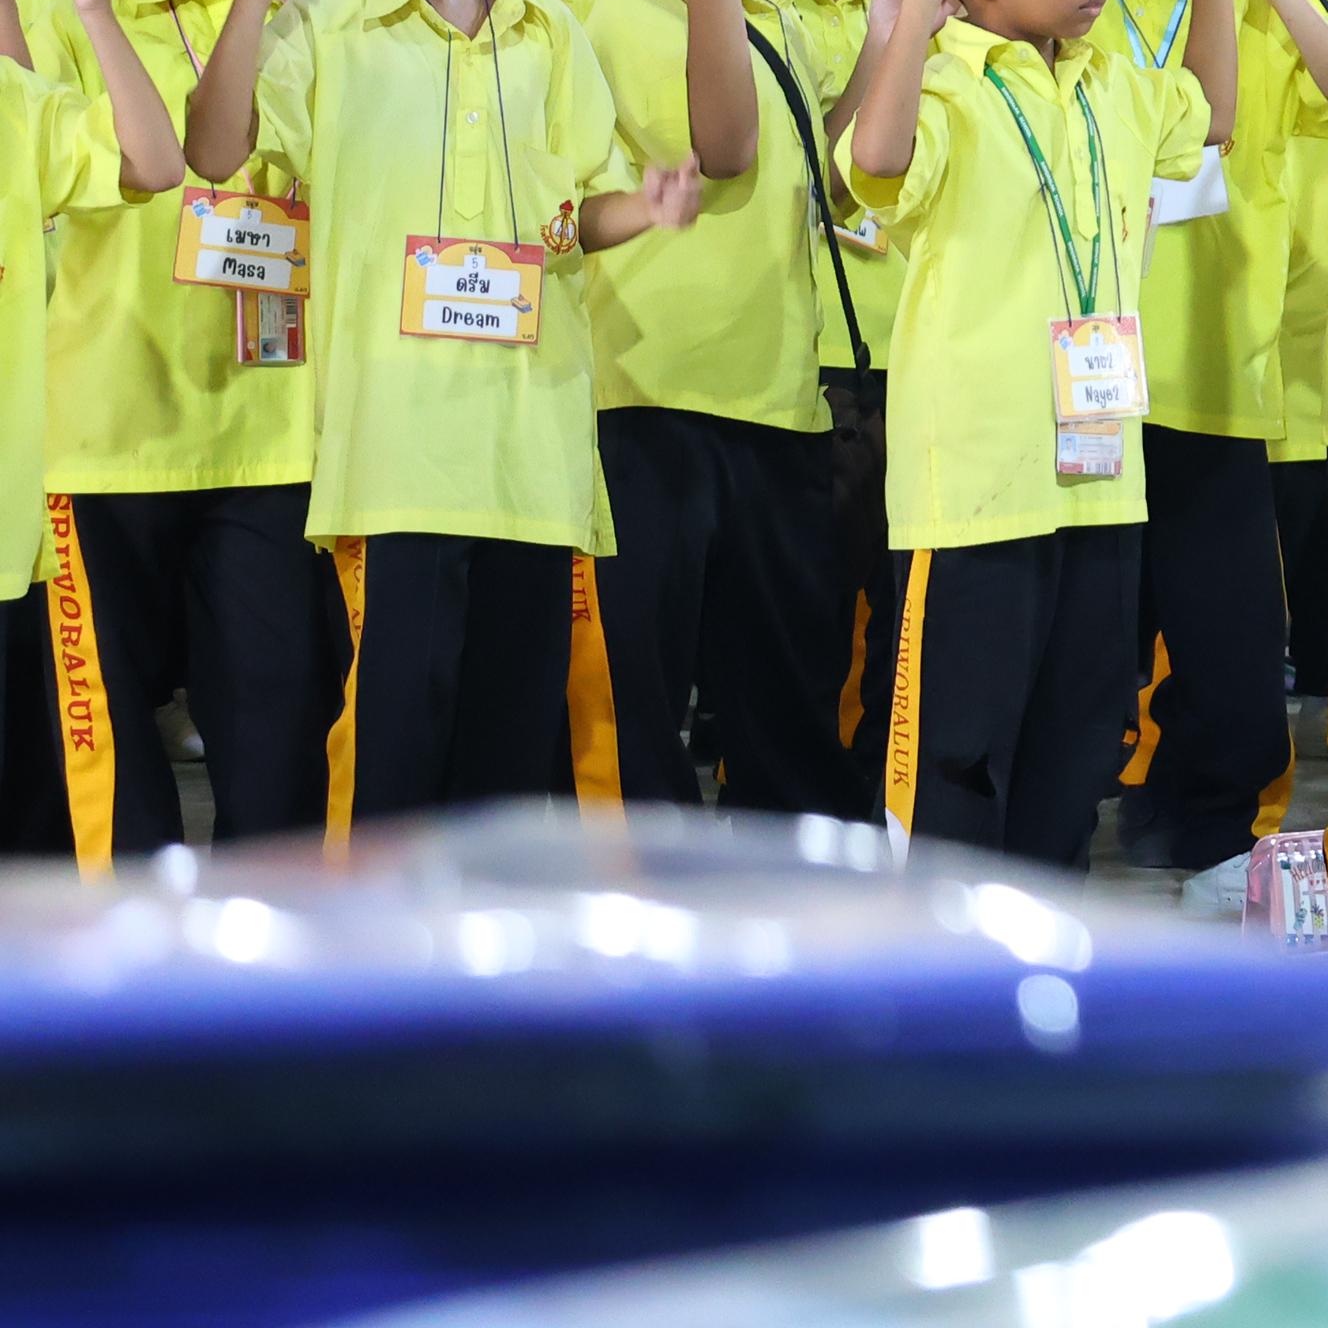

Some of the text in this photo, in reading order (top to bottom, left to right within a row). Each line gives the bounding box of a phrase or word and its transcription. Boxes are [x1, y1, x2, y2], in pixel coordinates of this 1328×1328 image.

[222, 257, 266, 280] Masa
[471, 257, 479, 269] 5
[456, 272, 491, 294] ดรีม
[441, 306, 501, 328] Dream
